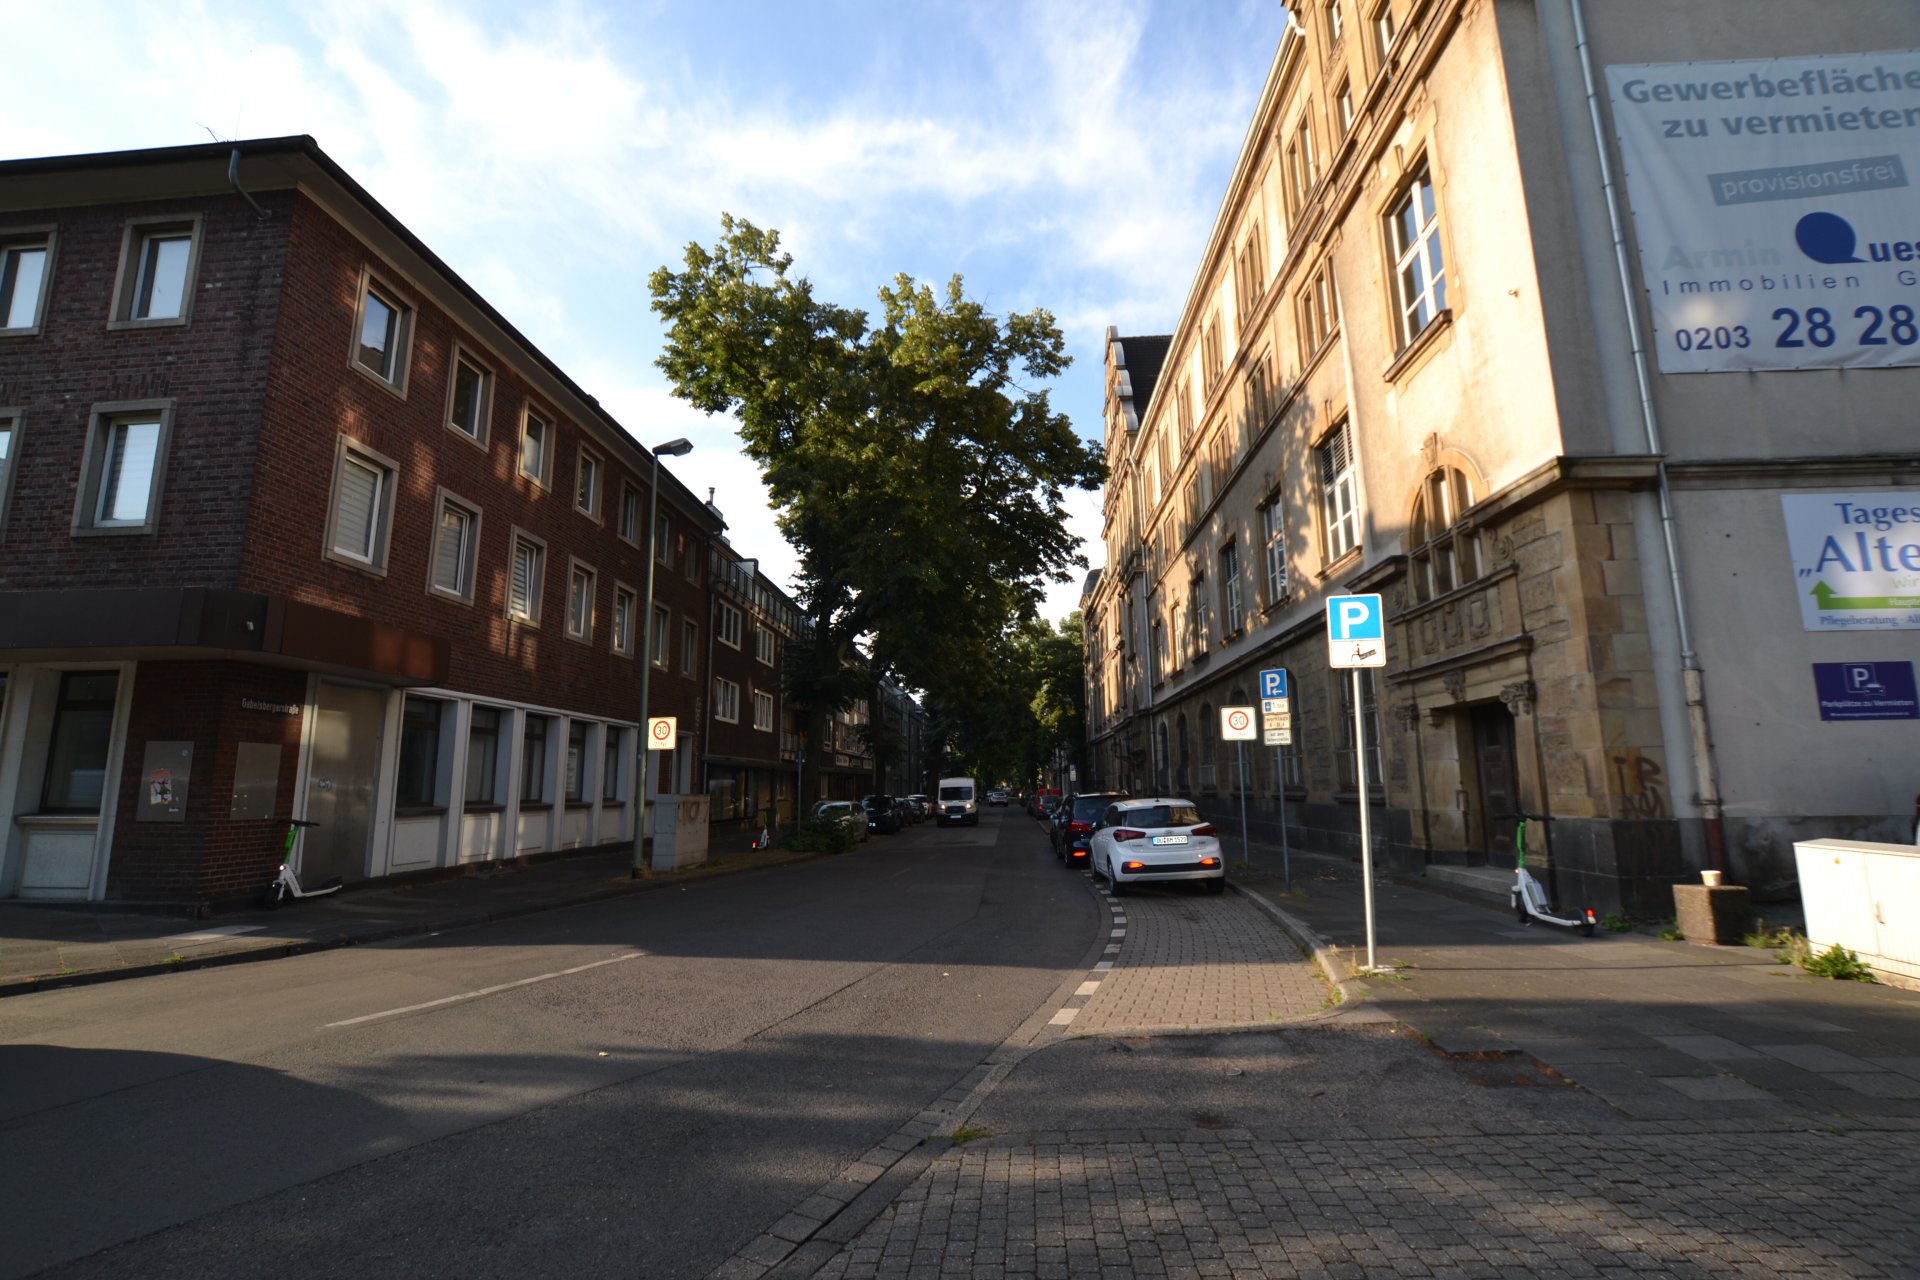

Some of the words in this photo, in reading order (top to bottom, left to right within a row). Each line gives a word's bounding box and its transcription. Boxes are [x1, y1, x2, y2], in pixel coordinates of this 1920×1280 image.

[1661, 118, 1709, 139] zu
[1720, 160, 1898, 200] provisionsfrei
[1662, 239, 1782, 271] Armin
[1663, 273, 1860, 295] Immobilien
[1675, 325, 1751, 351] 0203
[1772, 307, 1836, 348] 28
[1854, 304, 1919, 346] 28
[1833, 502, 1920, 532] Tages
[1339, 601, 1370, 639] P
[1266, 673, 1281, 696] P
[1852, 667, 1870, 689] P
[657, 726, 667, 735] 30
[1232, 715, 1245, 726] 30
